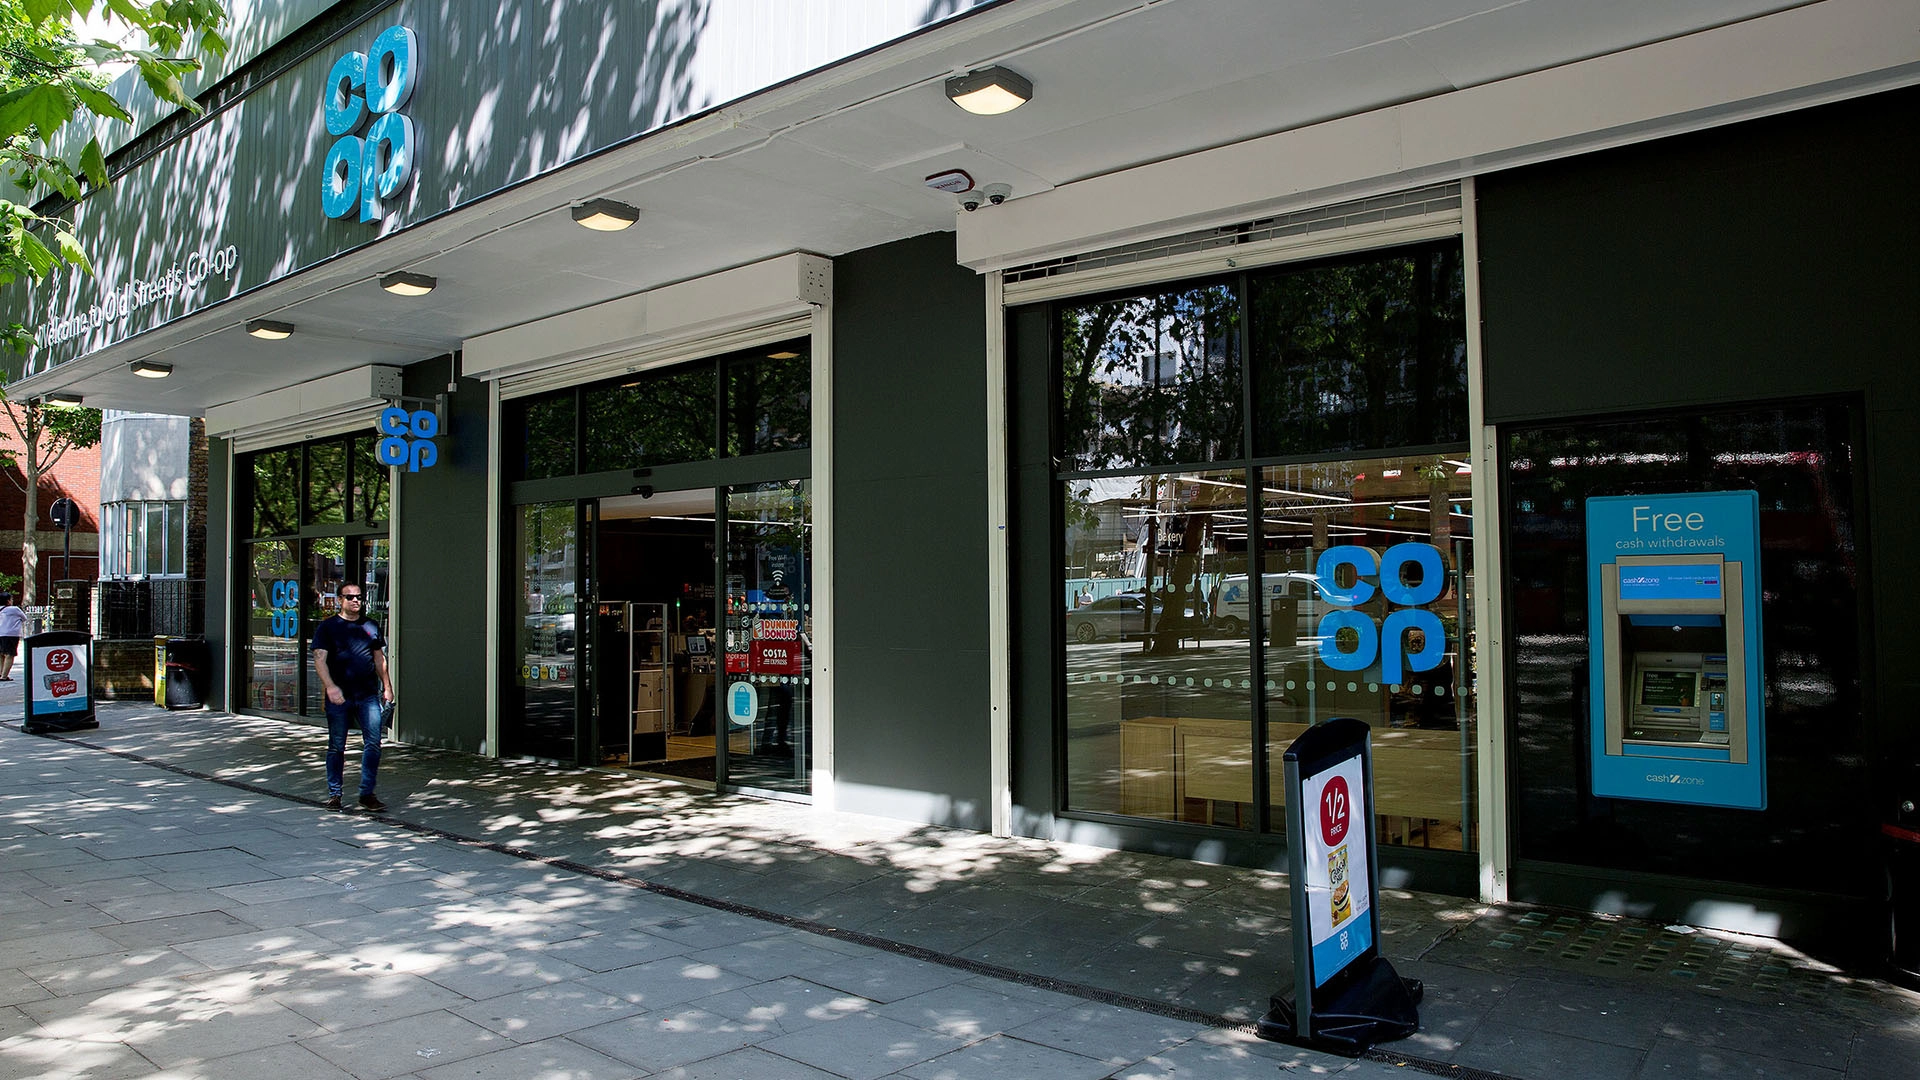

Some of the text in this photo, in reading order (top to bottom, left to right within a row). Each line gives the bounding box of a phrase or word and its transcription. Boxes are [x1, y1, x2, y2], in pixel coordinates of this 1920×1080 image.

[37, 311, 88, 350] Welcome
[88, 303, 102, 328] to
[105, 283, 130, 321] Old
[186, 245, 237, 286] Co-op
[1633, 506, 1705, 532] Free
[1157, 528, 1184, 547] Bakery
[1615, 535, 1725, 549] cash withdrawals
[764, 619, 798, 630] DUNKIN'
[764, 629, 797, 639] DONUTS
[51, 653, 69, 665] £2
[762, 648, 787, 659] COSTA
[1325, 787, 1345, 825] 1/2
[1330, 823, 1343, 837] PRICE
